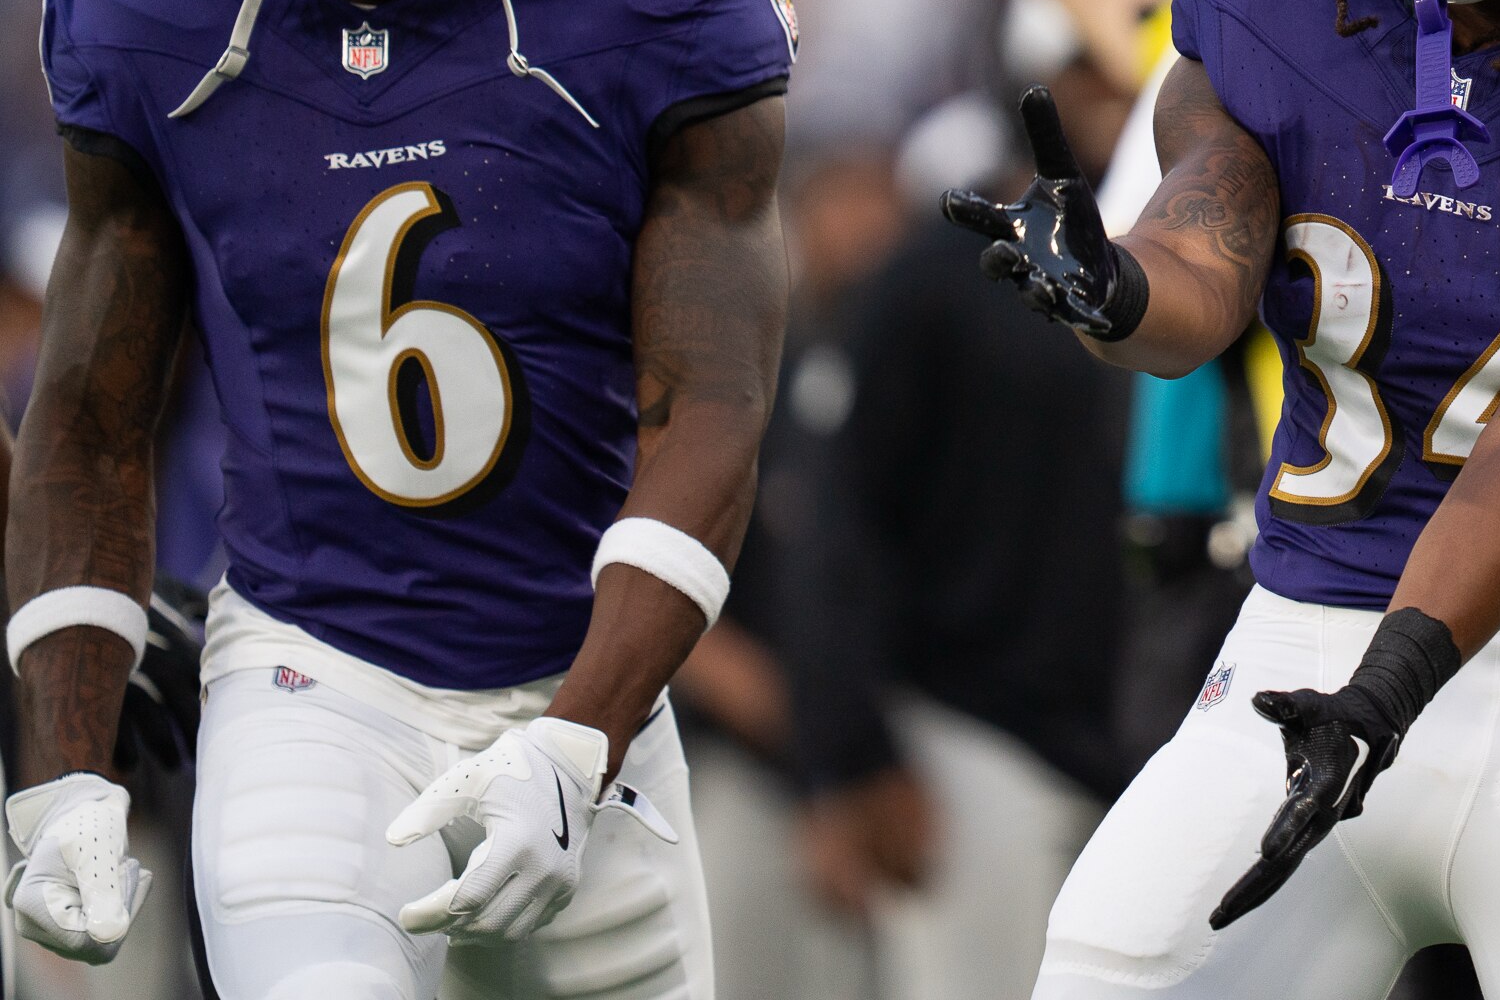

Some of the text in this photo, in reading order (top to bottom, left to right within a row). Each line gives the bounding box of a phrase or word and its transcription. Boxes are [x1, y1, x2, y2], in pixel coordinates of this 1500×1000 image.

[351, 47, 381, 69] NFL
[323, 139, 447, 170] RAVENS
[320, 180, 514, 509] 6
